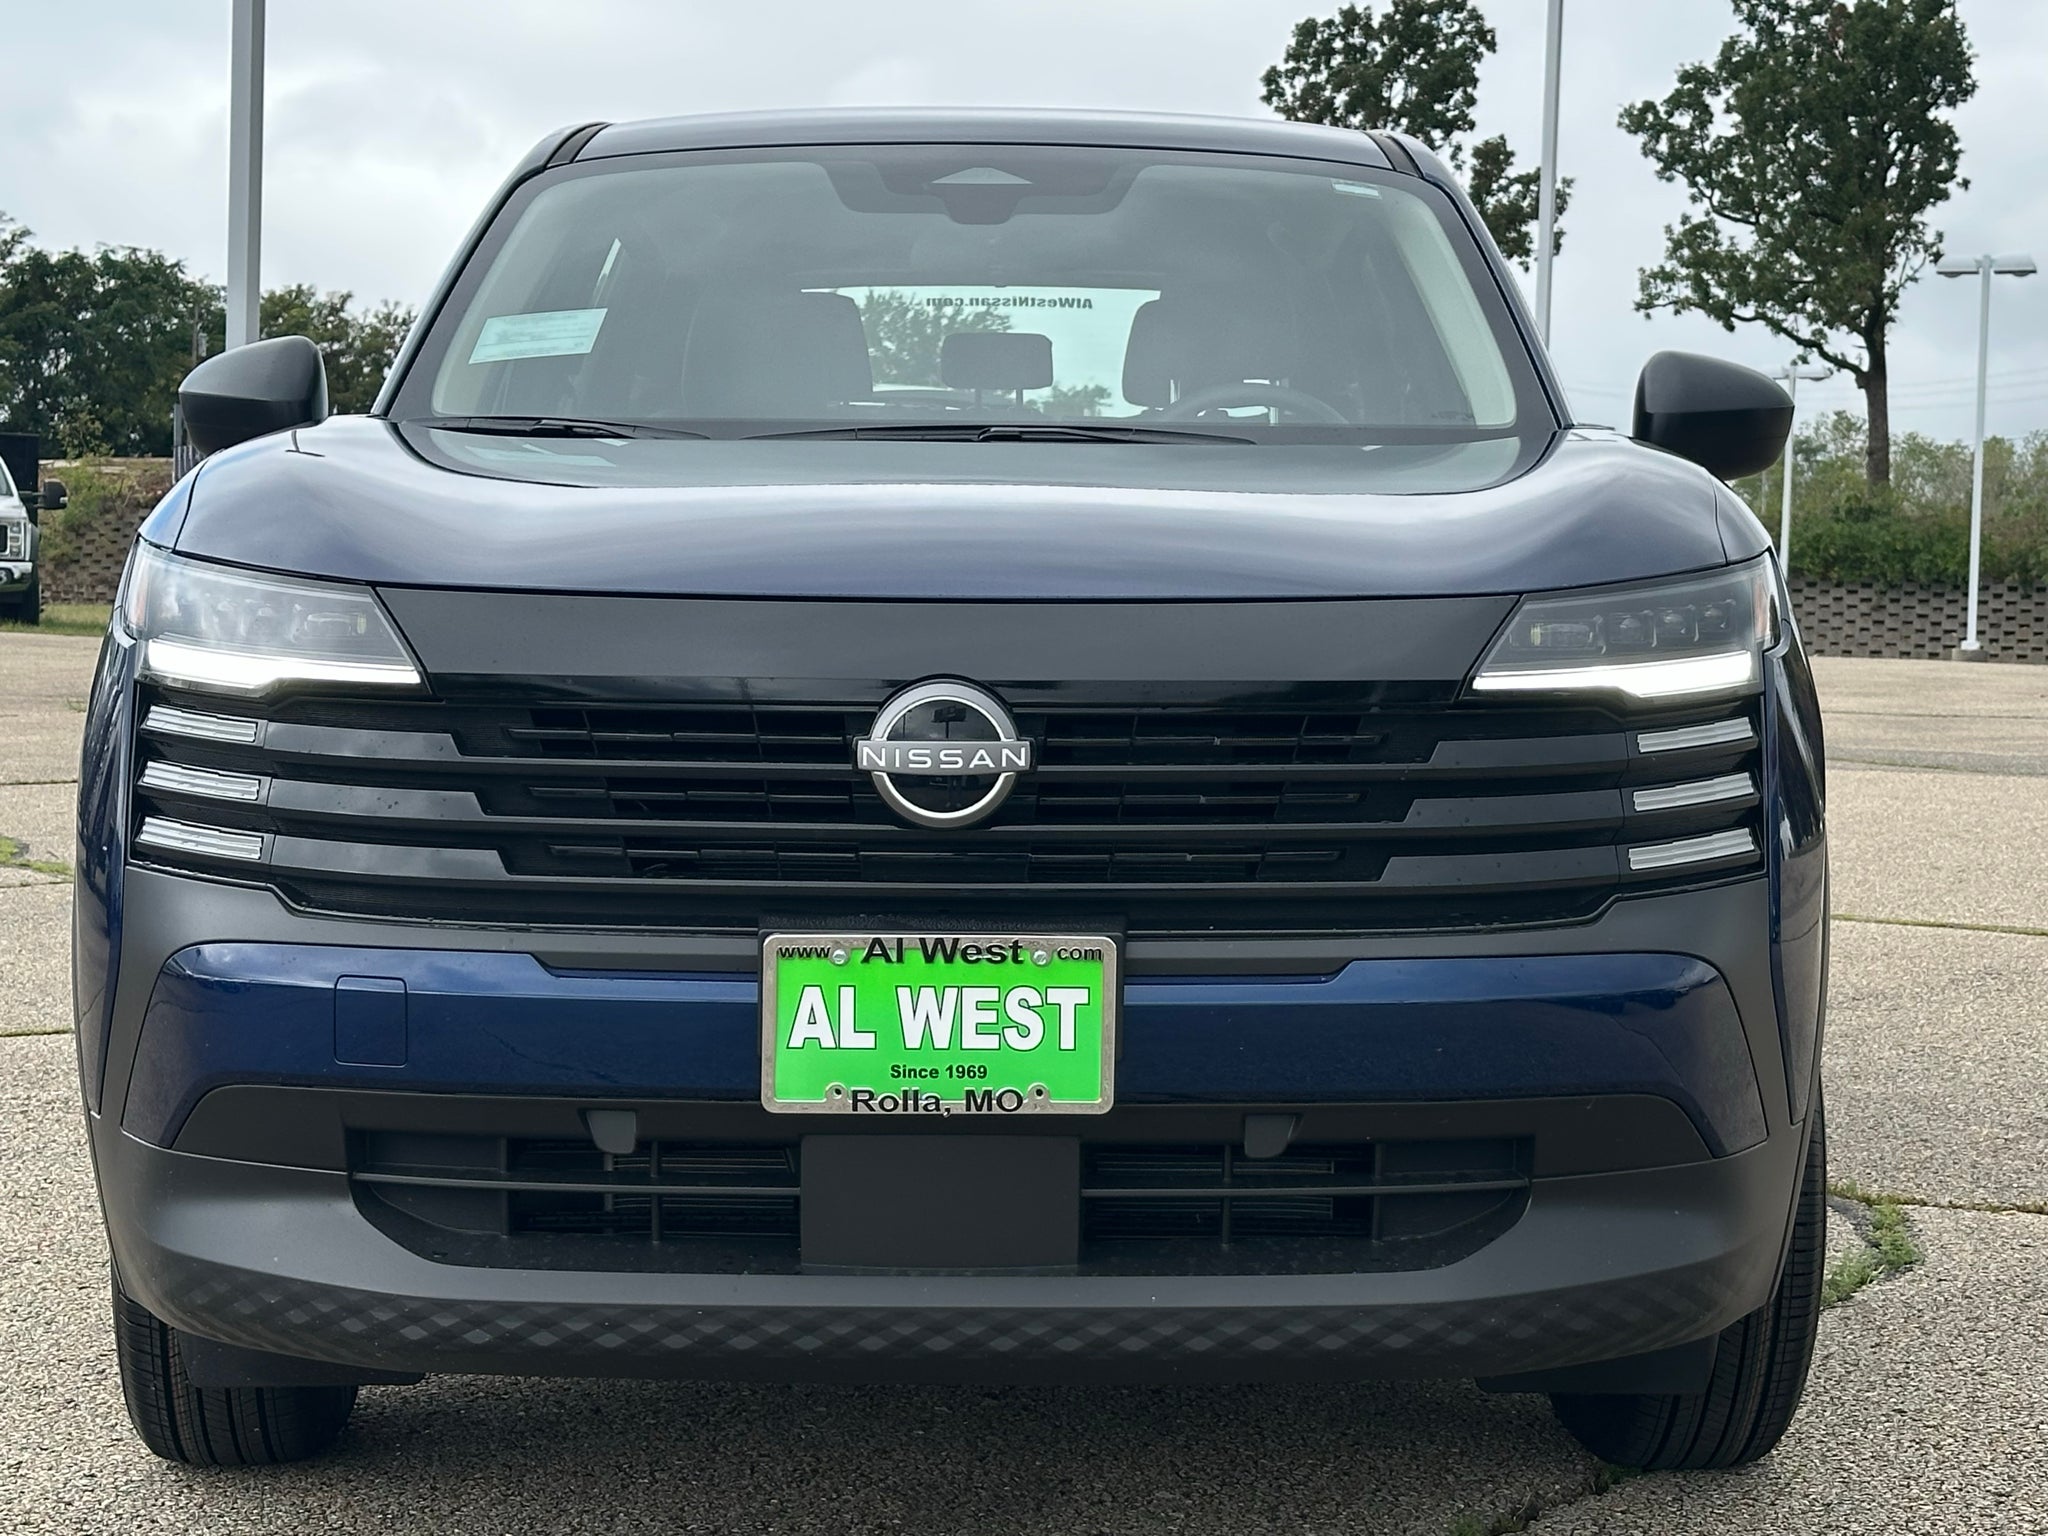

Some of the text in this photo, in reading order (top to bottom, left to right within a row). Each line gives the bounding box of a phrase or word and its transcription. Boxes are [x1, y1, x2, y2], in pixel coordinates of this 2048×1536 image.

[862, 746, 1026, 769] NISSAN
[860, 937, 904, 964] Al
[919, 937, 1025, 964] West
[786, 985, 1090, 1052] AL WEST
[890, 1064, 988, 1080] Since 1969
[851, 1088, 1025, 1116] Rolla, MO
